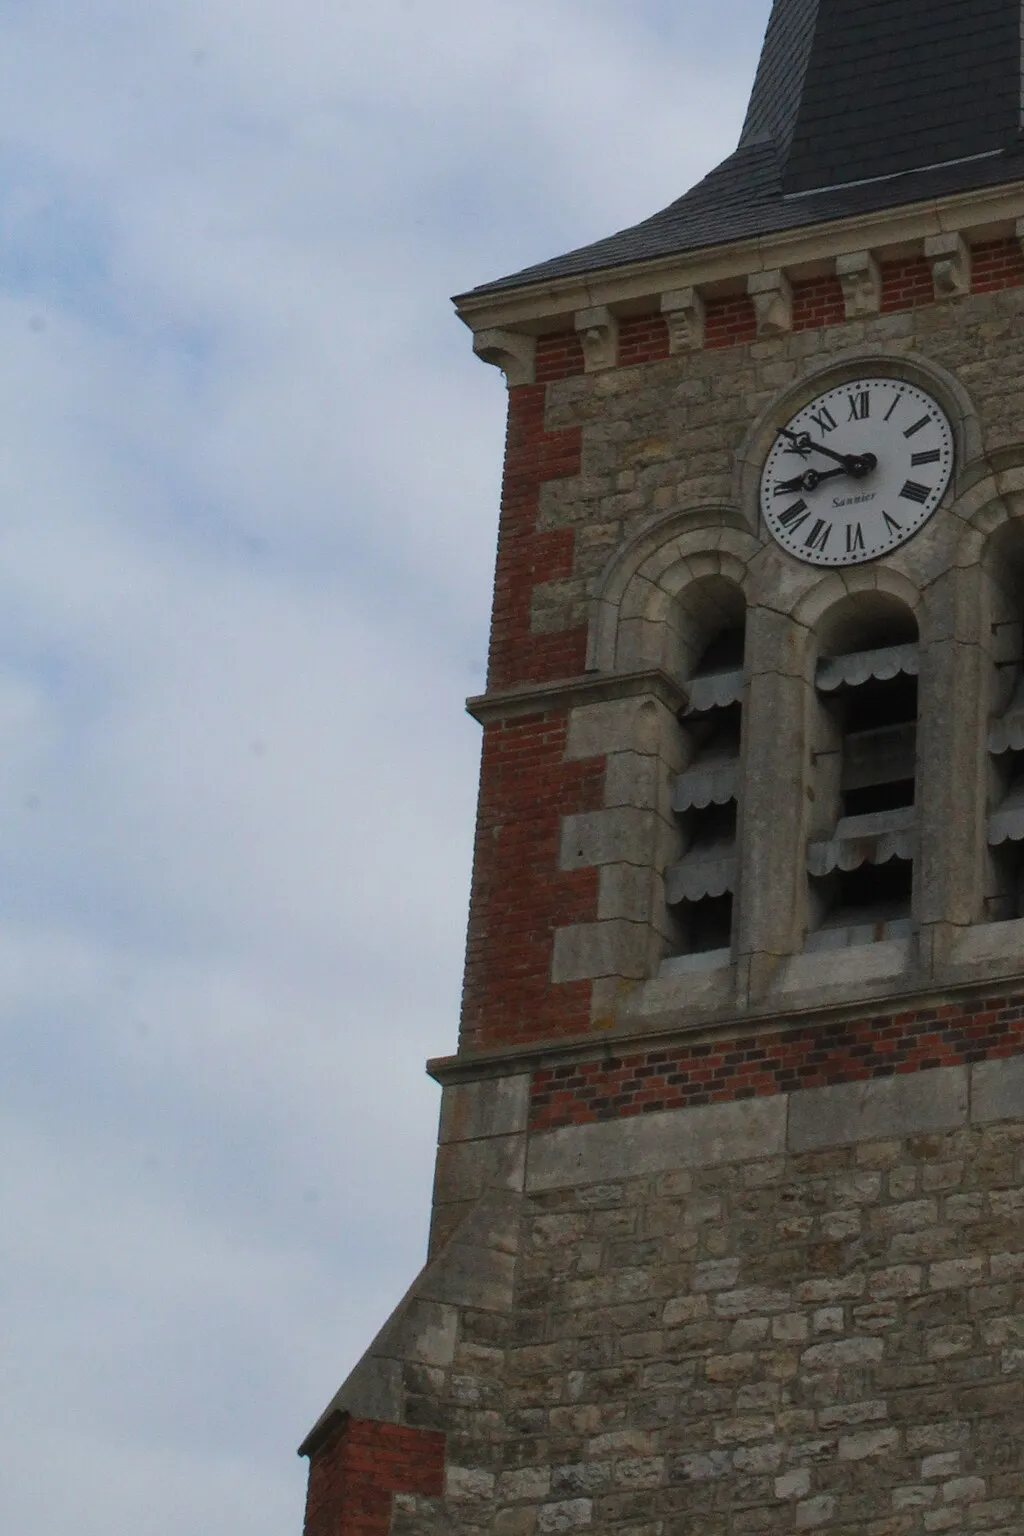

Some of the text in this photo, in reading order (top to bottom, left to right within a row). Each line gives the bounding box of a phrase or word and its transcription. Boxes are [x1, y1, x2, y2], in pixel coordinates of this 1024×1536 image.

[848, 390, 870, 421] XII
[883, 393, 901, 421] I
[809, 406, 838, 439] XI
[902, 413, 932, 439] II
[911, 448, 941, 468] III
[777, 498, 811, 536] VIII
[882, 510, 902, 536] V
[804, 518, 832, 552] VII
[846, 521, 866, 553] VI
